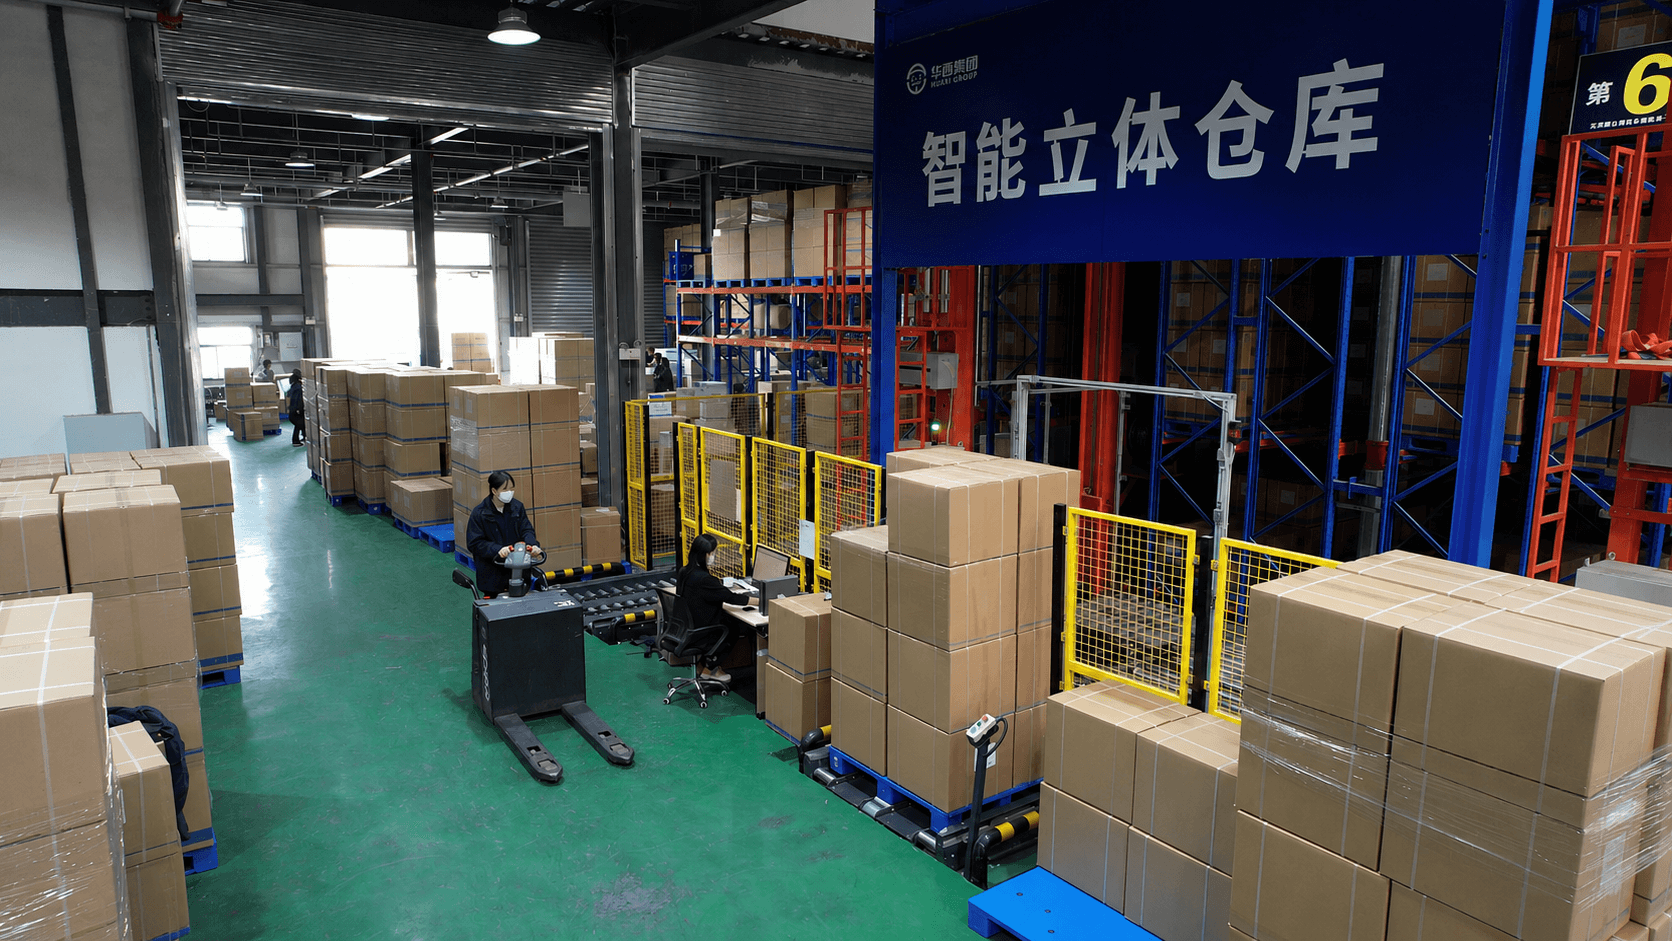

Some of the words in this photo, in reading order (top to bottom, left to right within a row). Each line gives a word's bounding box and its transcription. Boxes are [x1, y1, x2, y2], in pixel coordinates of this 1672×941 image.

[931, 54, 979, 80] 华西集团
[952, 71, 978, 83] GROUP
[922, 58, 1385, 208] 智能立体仓库
